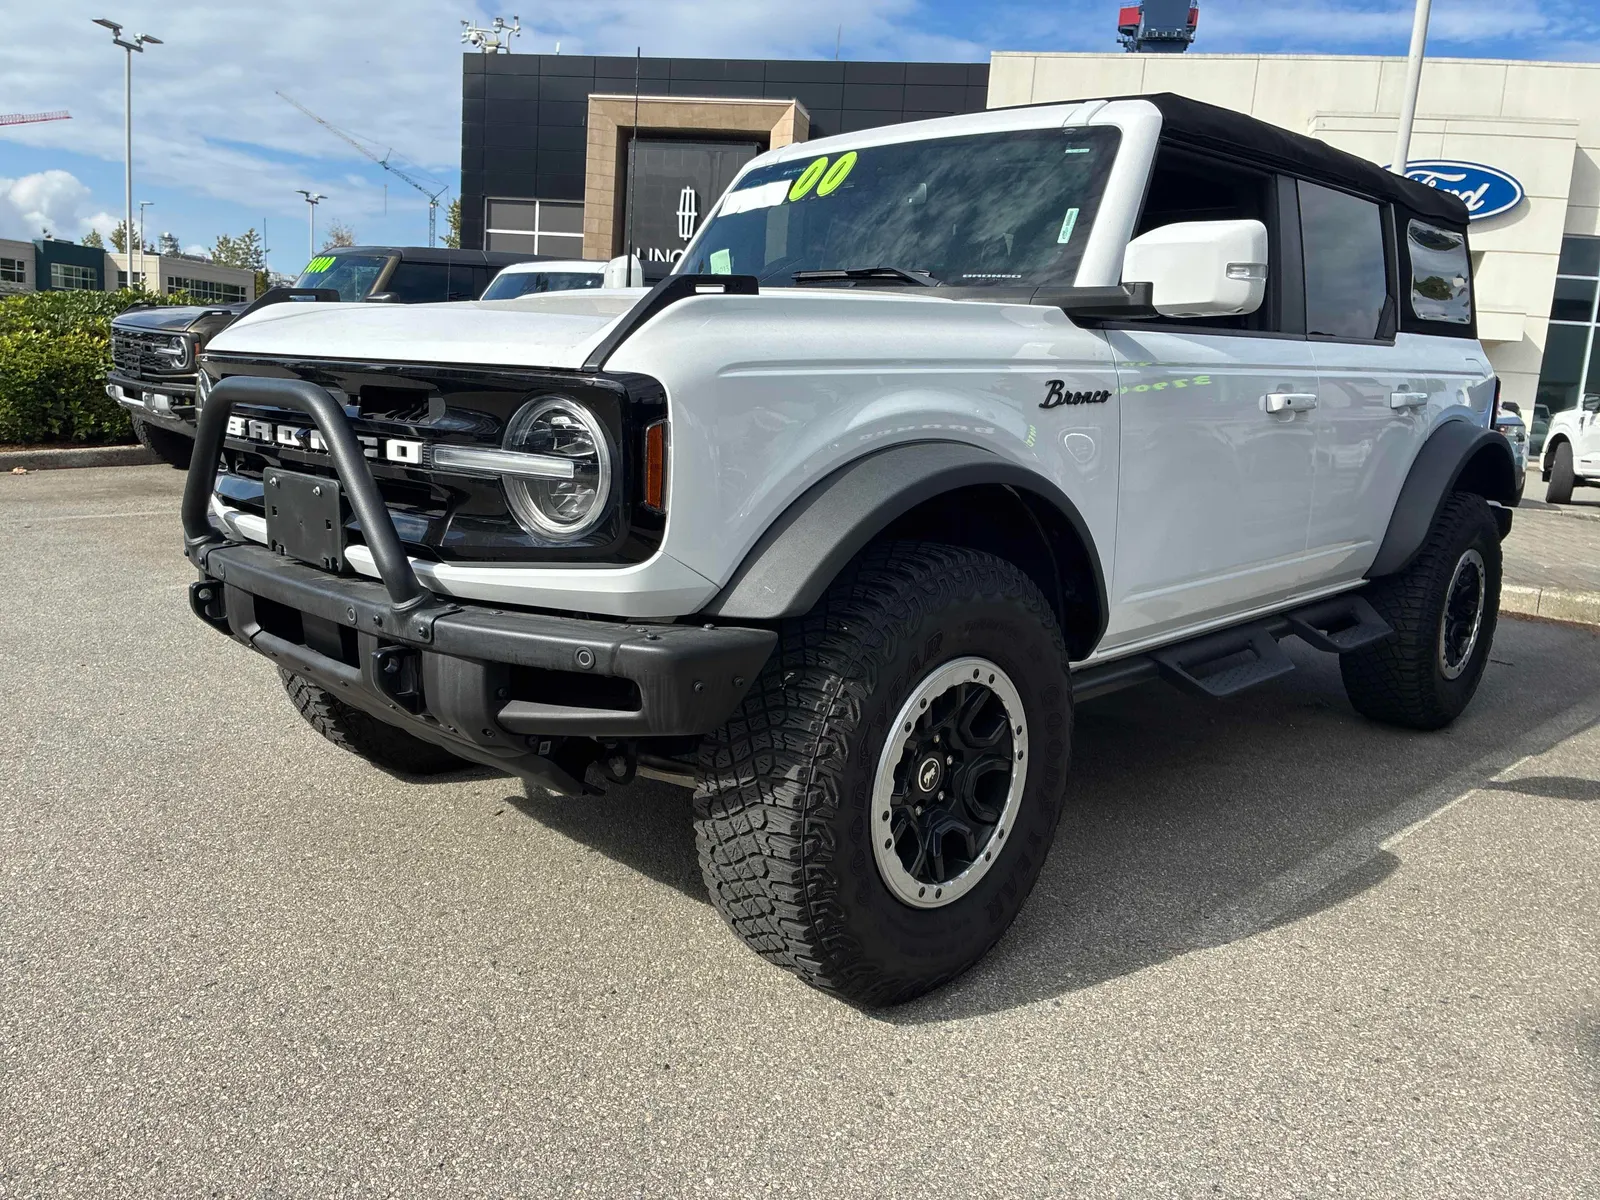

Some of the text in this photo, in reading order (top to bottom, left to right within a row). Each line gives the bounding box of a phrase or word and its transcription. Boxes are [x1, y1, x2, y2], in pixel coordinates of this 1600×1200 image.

[789, 151, 858, 202] 00
[1403, 170, 1491, 212] Fd
[1039, 379, 1112, 409] Bronco
